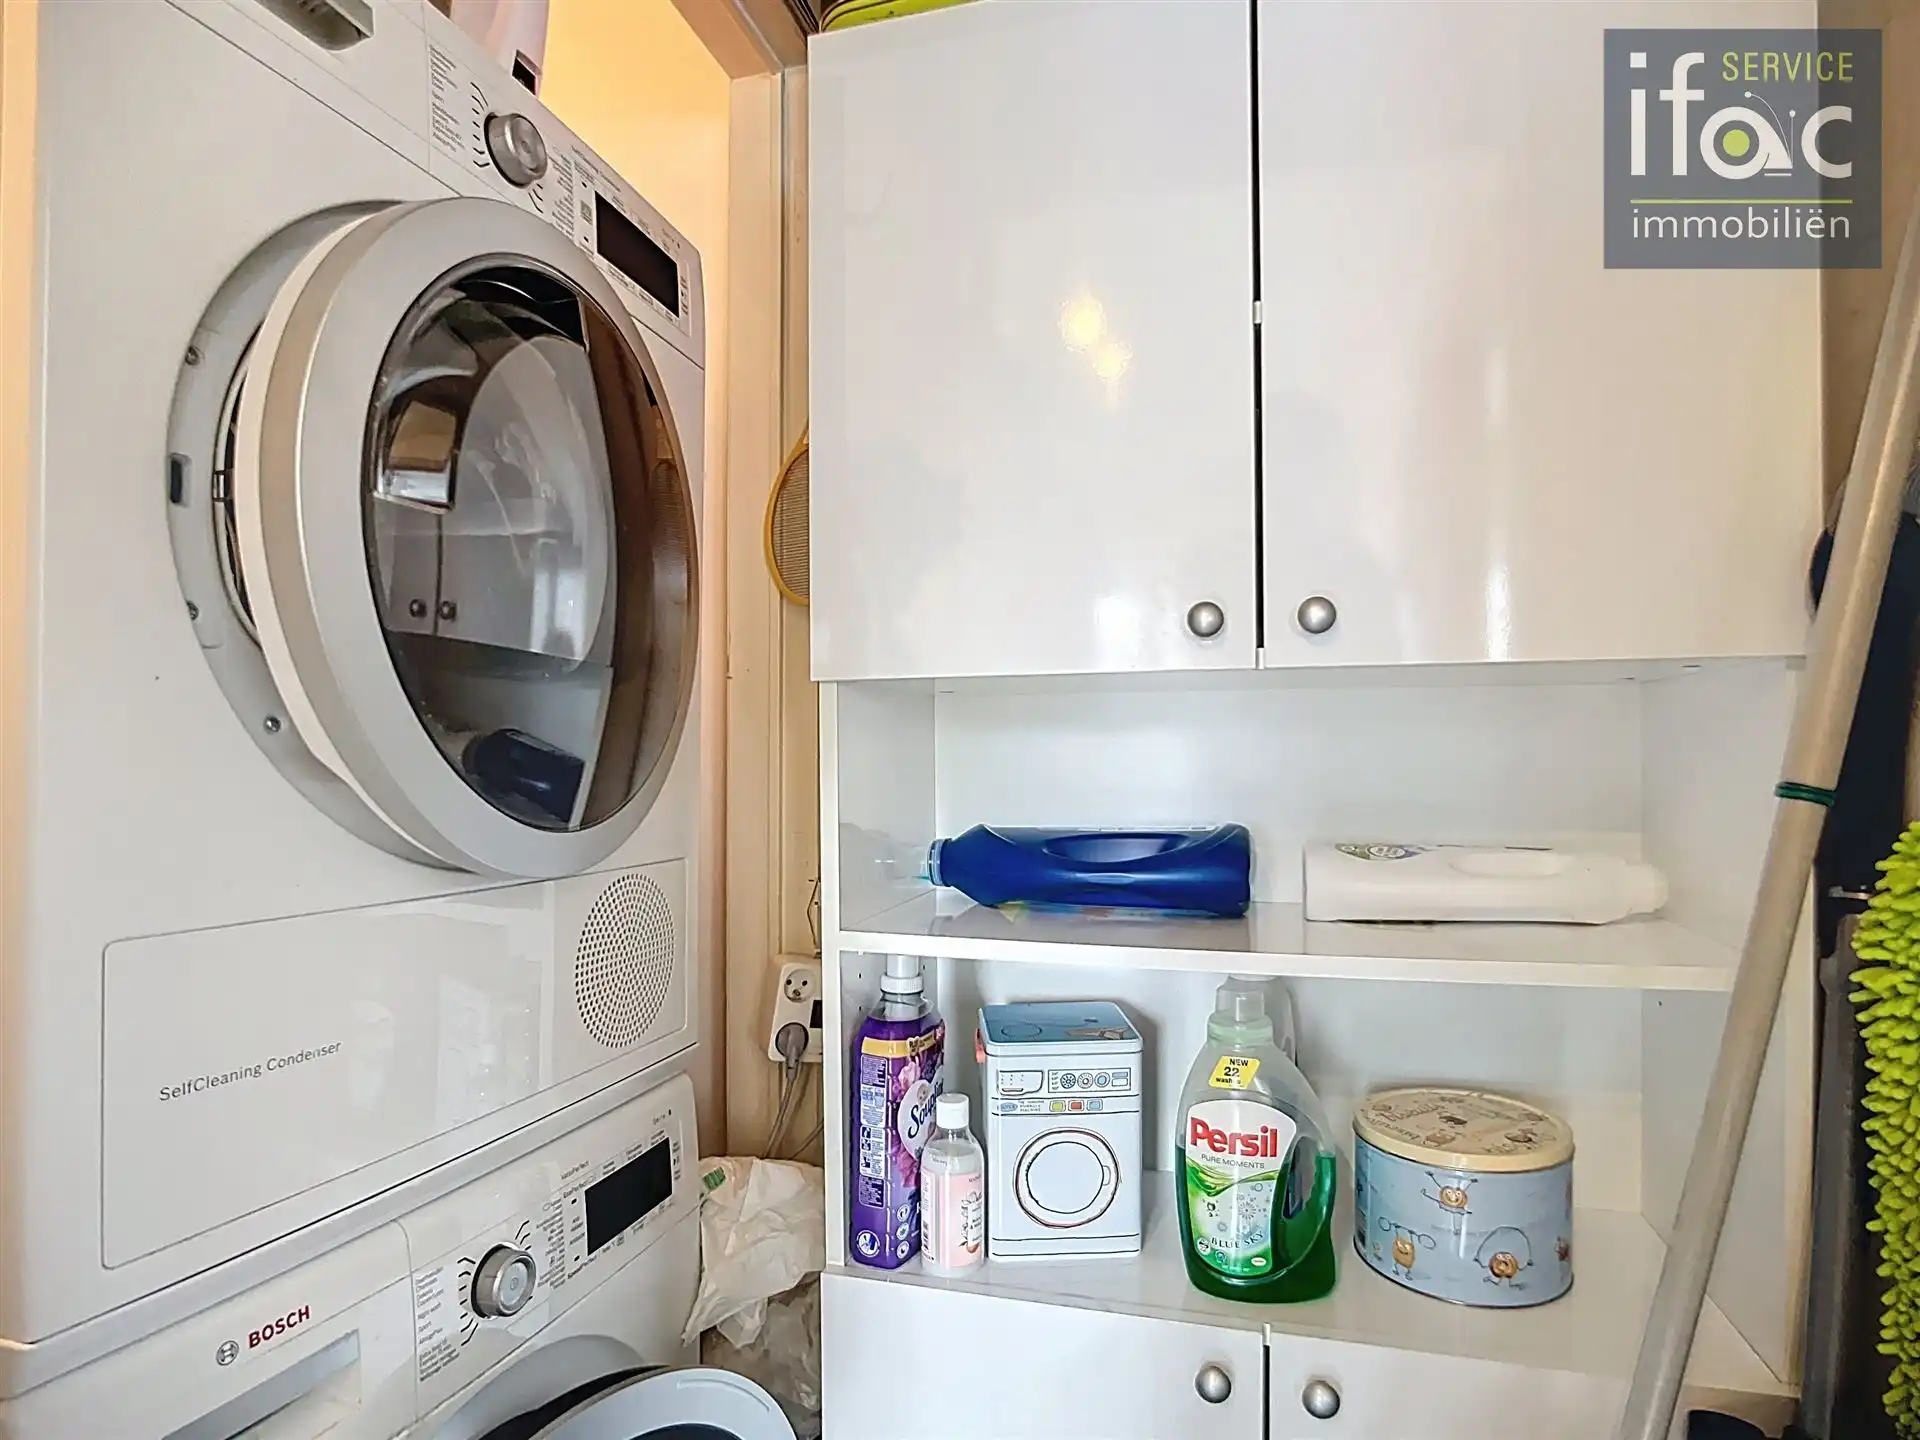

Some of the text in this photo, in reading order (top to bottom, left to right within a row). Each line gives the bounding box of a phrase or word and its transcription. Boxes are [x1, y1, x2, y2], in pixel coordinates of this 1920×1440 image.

[1229, 1058, 1249, 1067] NEW
[159, 1041, 342, 1102] SelfCleaning Condenser
[1223, 1066, 1240, 1077] 22
[1215, 1076, 1242, 1085] washs
[1190, 1116, 1278, 1158] Persil
[1201, 1153, 1265, 1169] PURE MOMENTS
[248, 1304, 311, 1349] BOSCH
